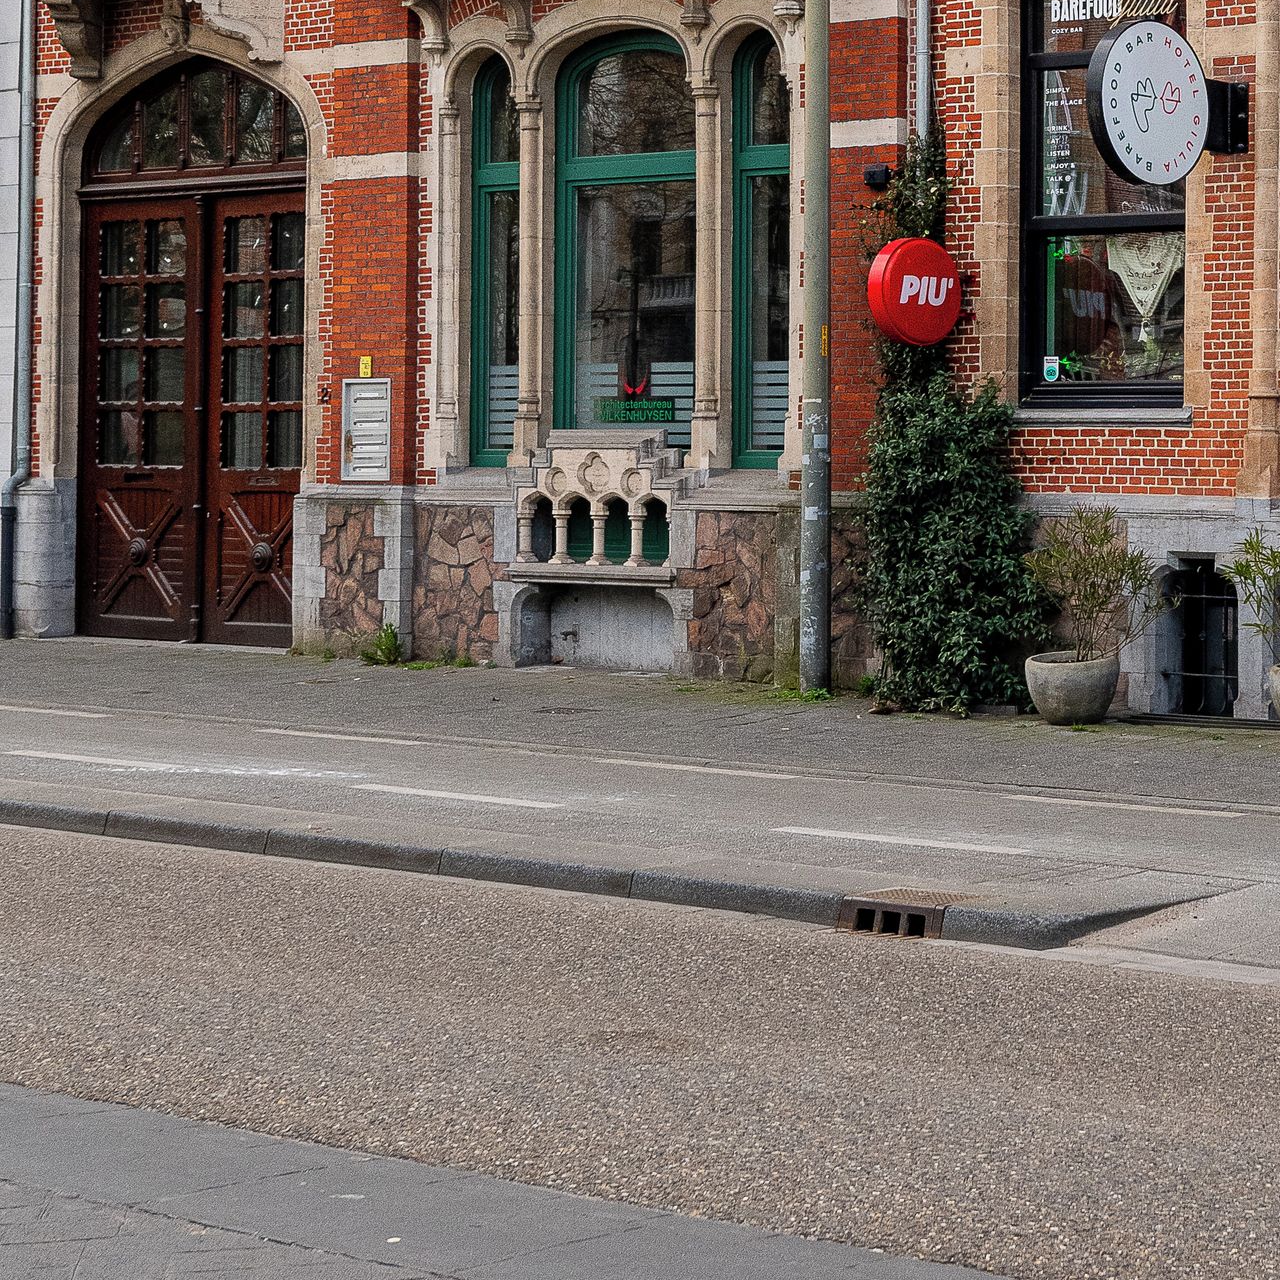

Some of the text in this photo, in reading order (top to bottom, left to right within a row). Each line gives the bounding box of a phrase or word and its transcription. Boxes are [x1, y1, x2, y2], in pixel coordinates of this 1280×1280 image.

[1051, 27, 1069, 35] COZY
[1125, 32, 1153, 54] BAR
[1164, 37, 1200, 98] HOTEL
[1060, 98, 1083, 106] PLACE
[1111, 62, 1153, 172] BAREFOOD
[1163, 115, 1201, 173] GIULIA
[1064, 174, 1072, 182] @
[594, 398, 672, 409] rchitectenbureau
